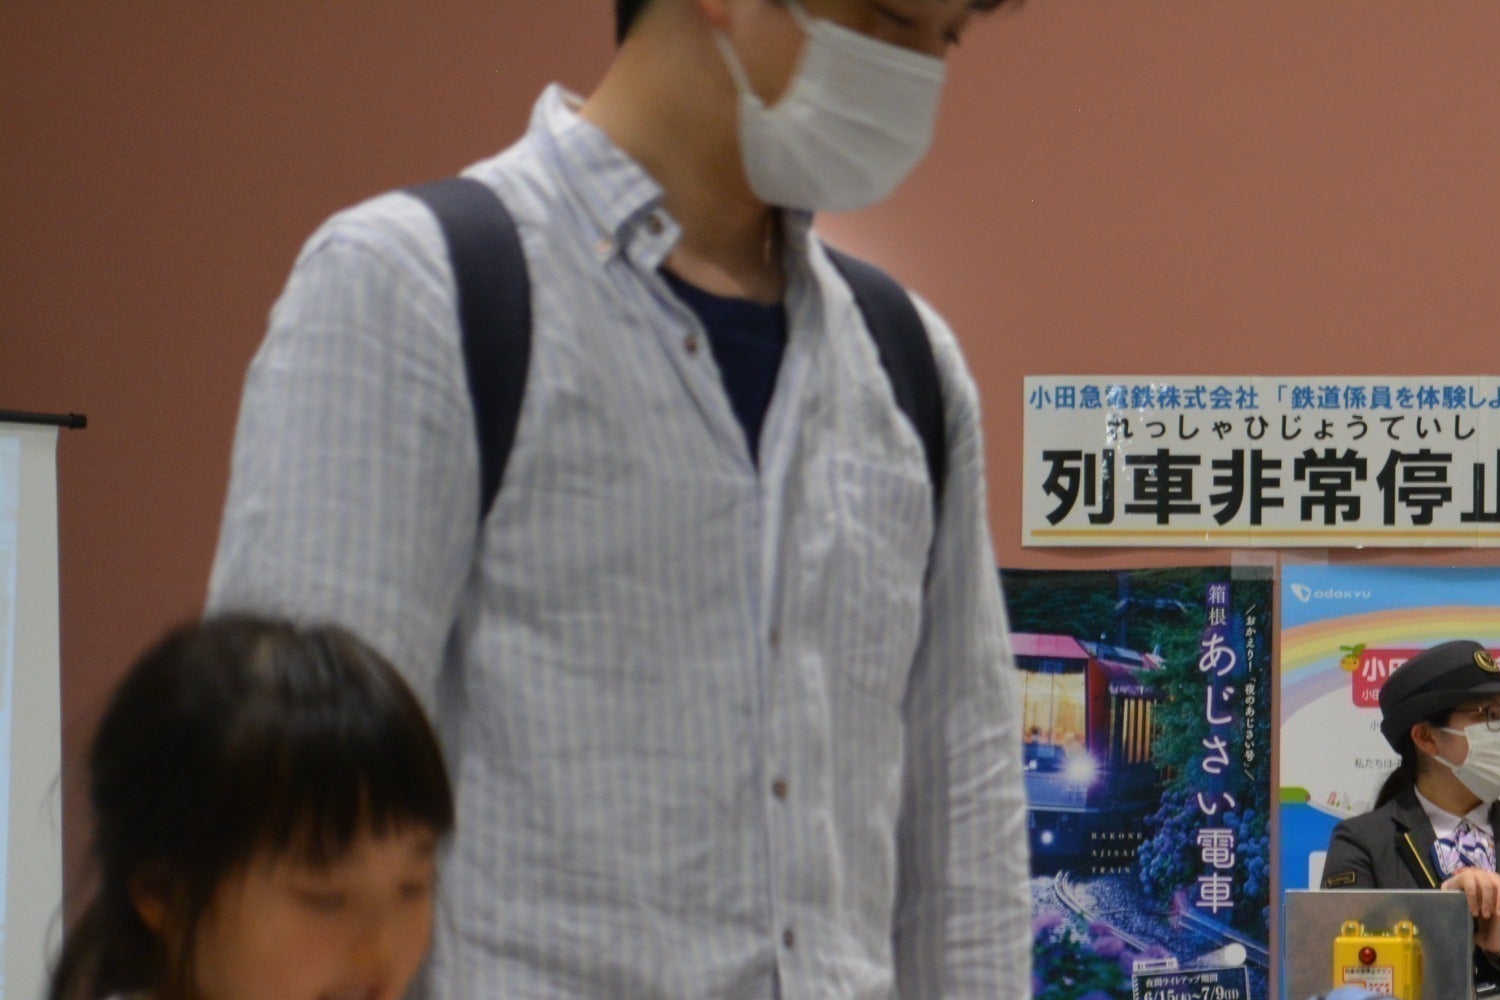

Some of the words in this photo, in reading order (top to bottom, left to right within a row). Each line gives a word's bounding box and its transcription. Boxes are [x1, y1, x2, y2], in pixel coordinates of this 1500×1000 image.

[1107, 414, 1476, 441] れっしゃひじょうていし
[1208, 585, 1226, 626] 箱根
[1196, 633, 1237, 914] あじさい電車
